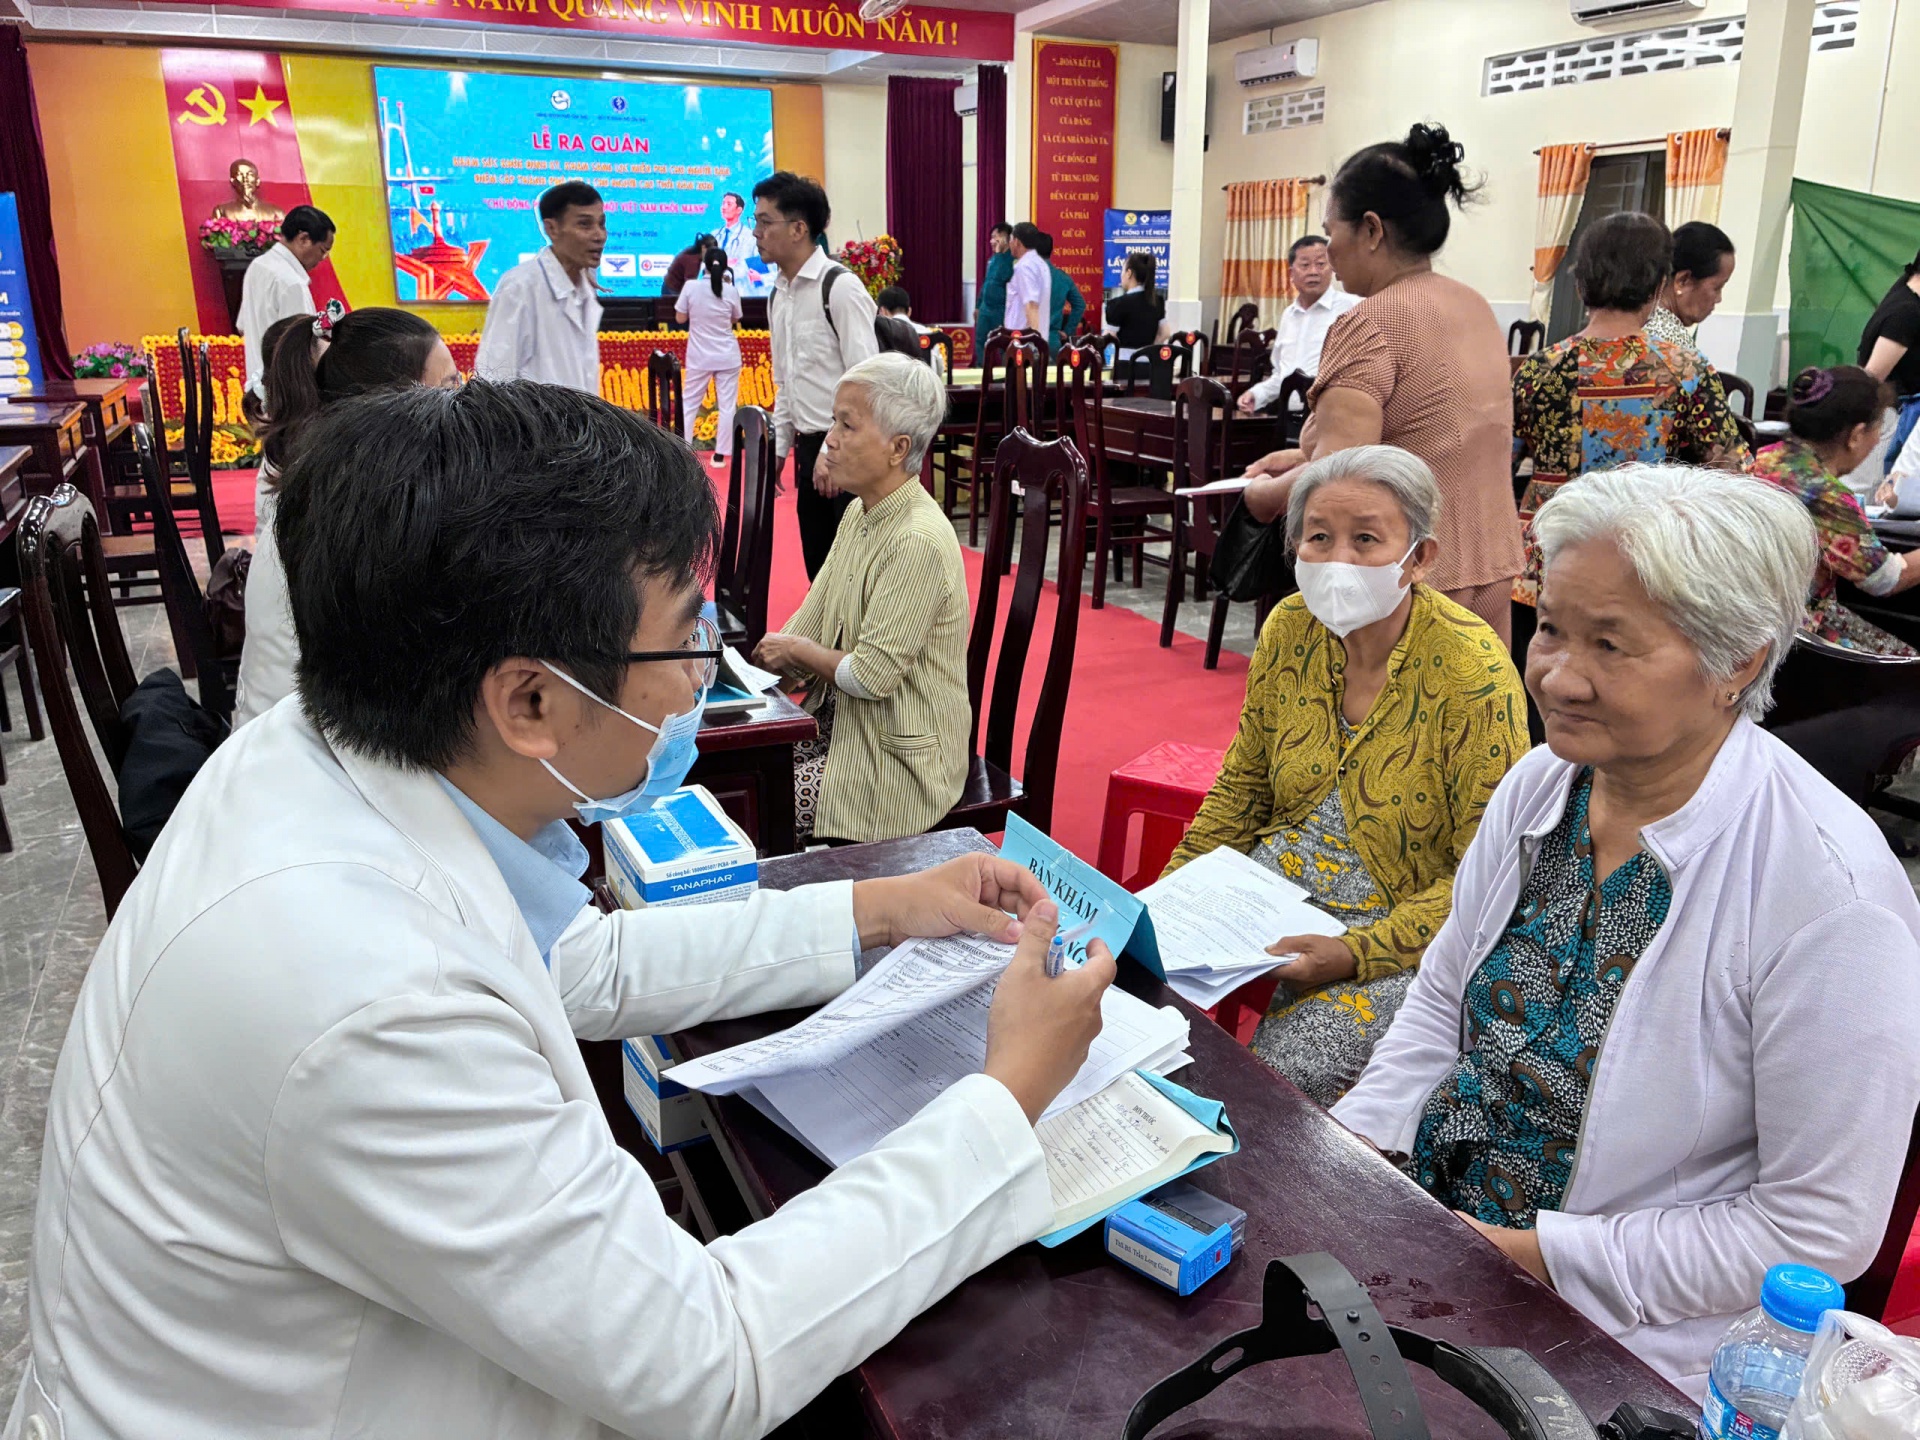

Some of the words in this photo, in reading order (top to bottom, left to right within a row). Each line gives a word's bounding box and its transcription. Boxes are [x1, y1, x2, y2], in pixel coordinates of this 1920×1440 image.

[679, 0, 763, 31] VINH
[771, 3, 866, 39] MUÔN
[532, 125, 552, 150] LỄ
[558, 134, 585, 151] RA
[590, 133, 650, 153] QUÂN
[670, 873, 733, 893] TANAPHAR
[1028, 857, 1055, 889] BÀN
[1052, 877, 1099, 925] KHÁM
